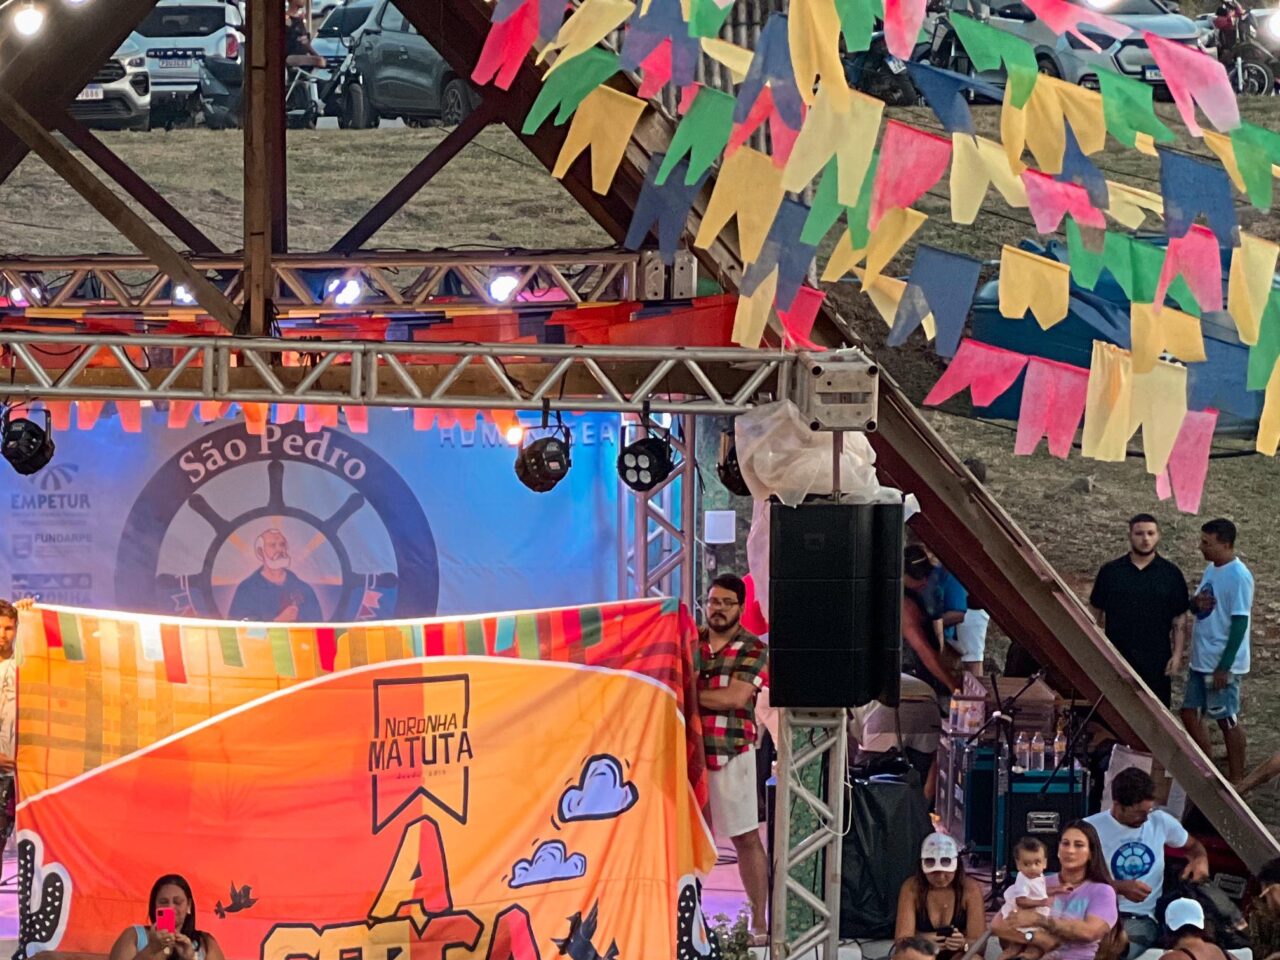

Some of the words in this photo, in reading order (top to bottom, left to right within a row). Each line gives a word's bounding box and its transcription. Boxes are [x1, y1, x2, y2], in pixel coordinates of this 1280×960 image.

[179, 439, 247, 484] São
[257, 424, 367, 481] Pedro
[10, 493, 91, 510] EMPETUR
[384, 712, 458, 739] NORONHA
[368, 730, 474, 772] MATUTA
[368, 814, 453, 918] A
